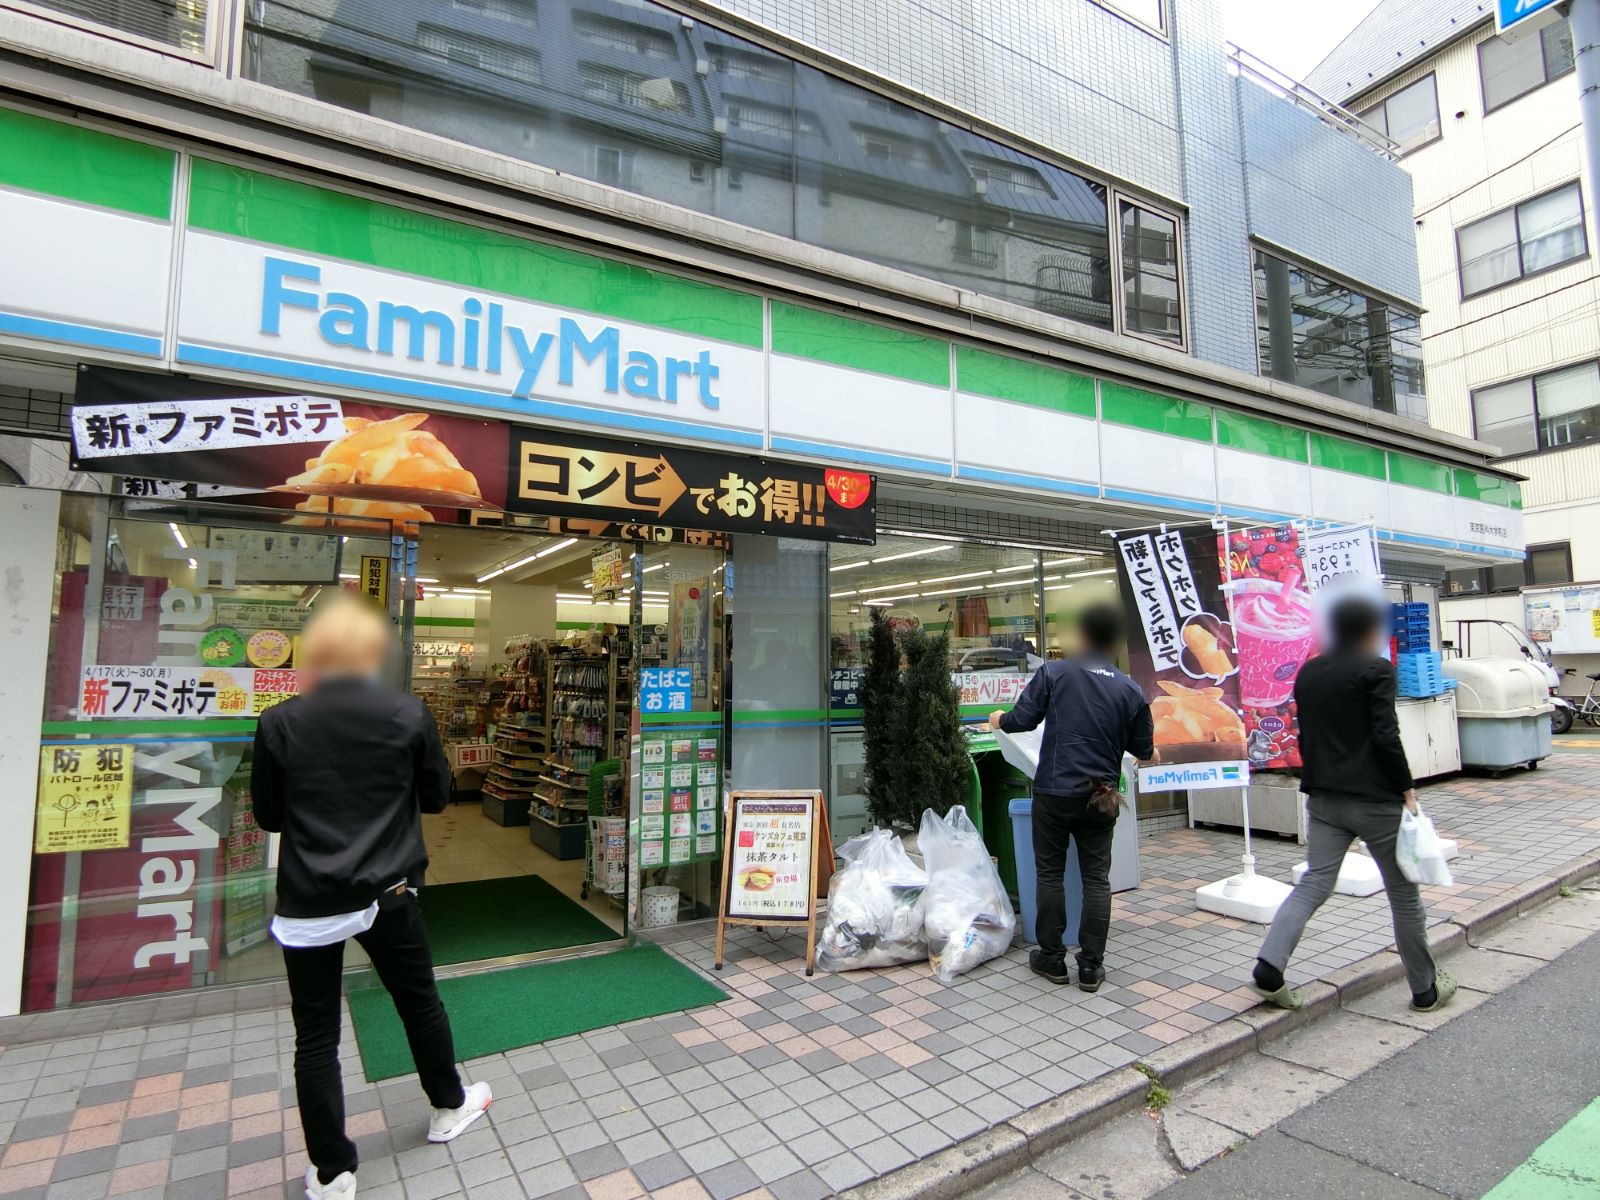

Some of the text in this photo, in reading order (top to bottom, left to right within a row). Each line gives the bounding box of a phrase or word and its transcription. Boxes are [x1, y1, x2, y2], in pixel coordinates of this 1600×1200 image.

[260, 256, 719, 410] FamilyMart
[85, 402, 339, 450] 新・ファミポテ
[641, 670, 690, 688] たばこ
[83, 676, 216, 716] 新ファミポテ
[646, 691, 685, 710] お酒
[50, 773, 124, 784] パトロール区域
